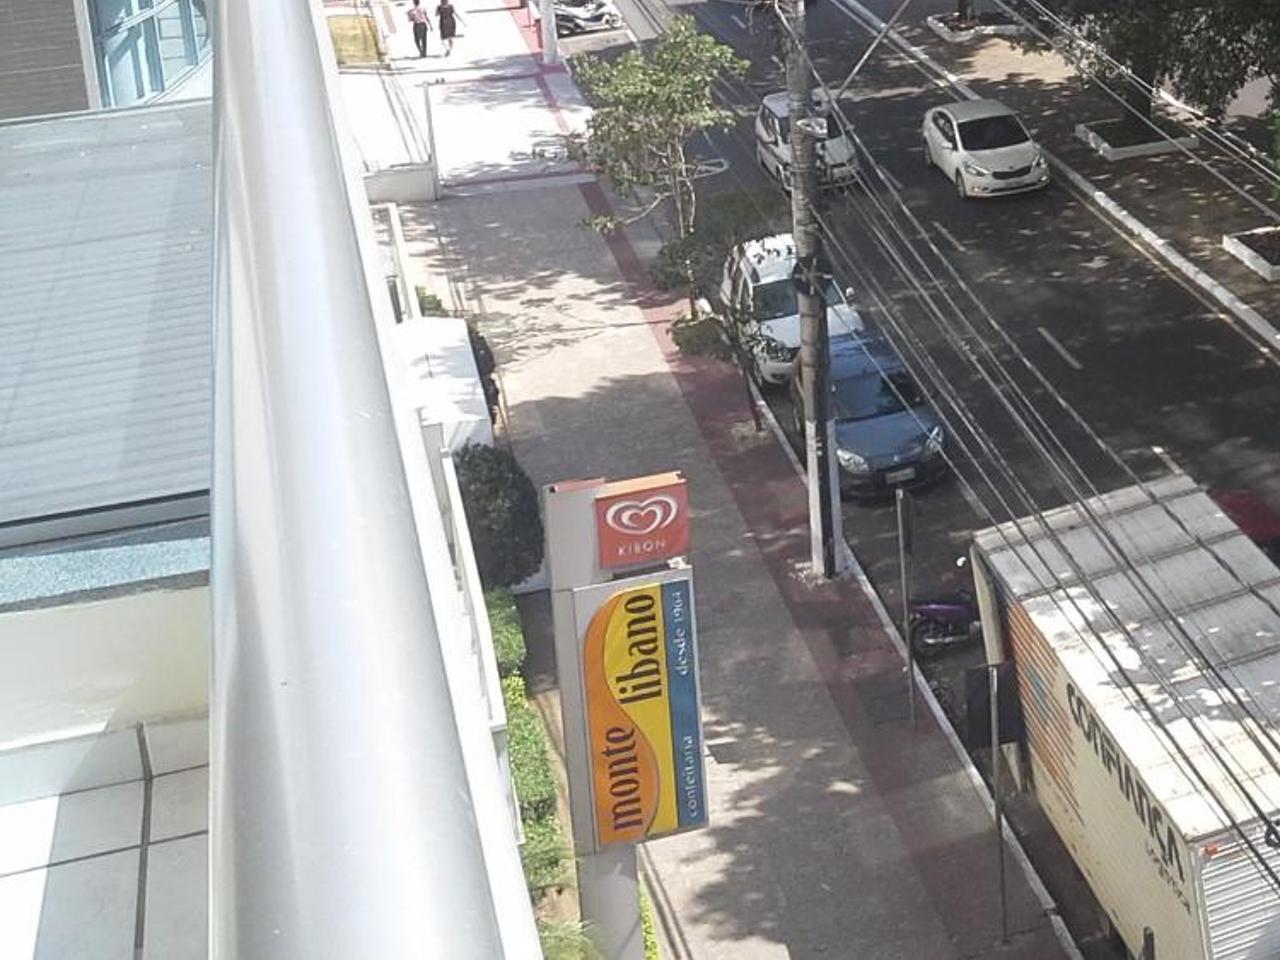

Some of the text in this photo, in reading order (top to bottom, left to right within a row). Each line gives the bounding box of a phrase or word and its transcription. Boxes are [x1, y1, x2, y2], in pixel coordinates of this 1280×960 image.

[618, 539, 666, 556] KIBON
[673, 627, 689, 676] desde
[602, 594, 662, 832] monte libano
